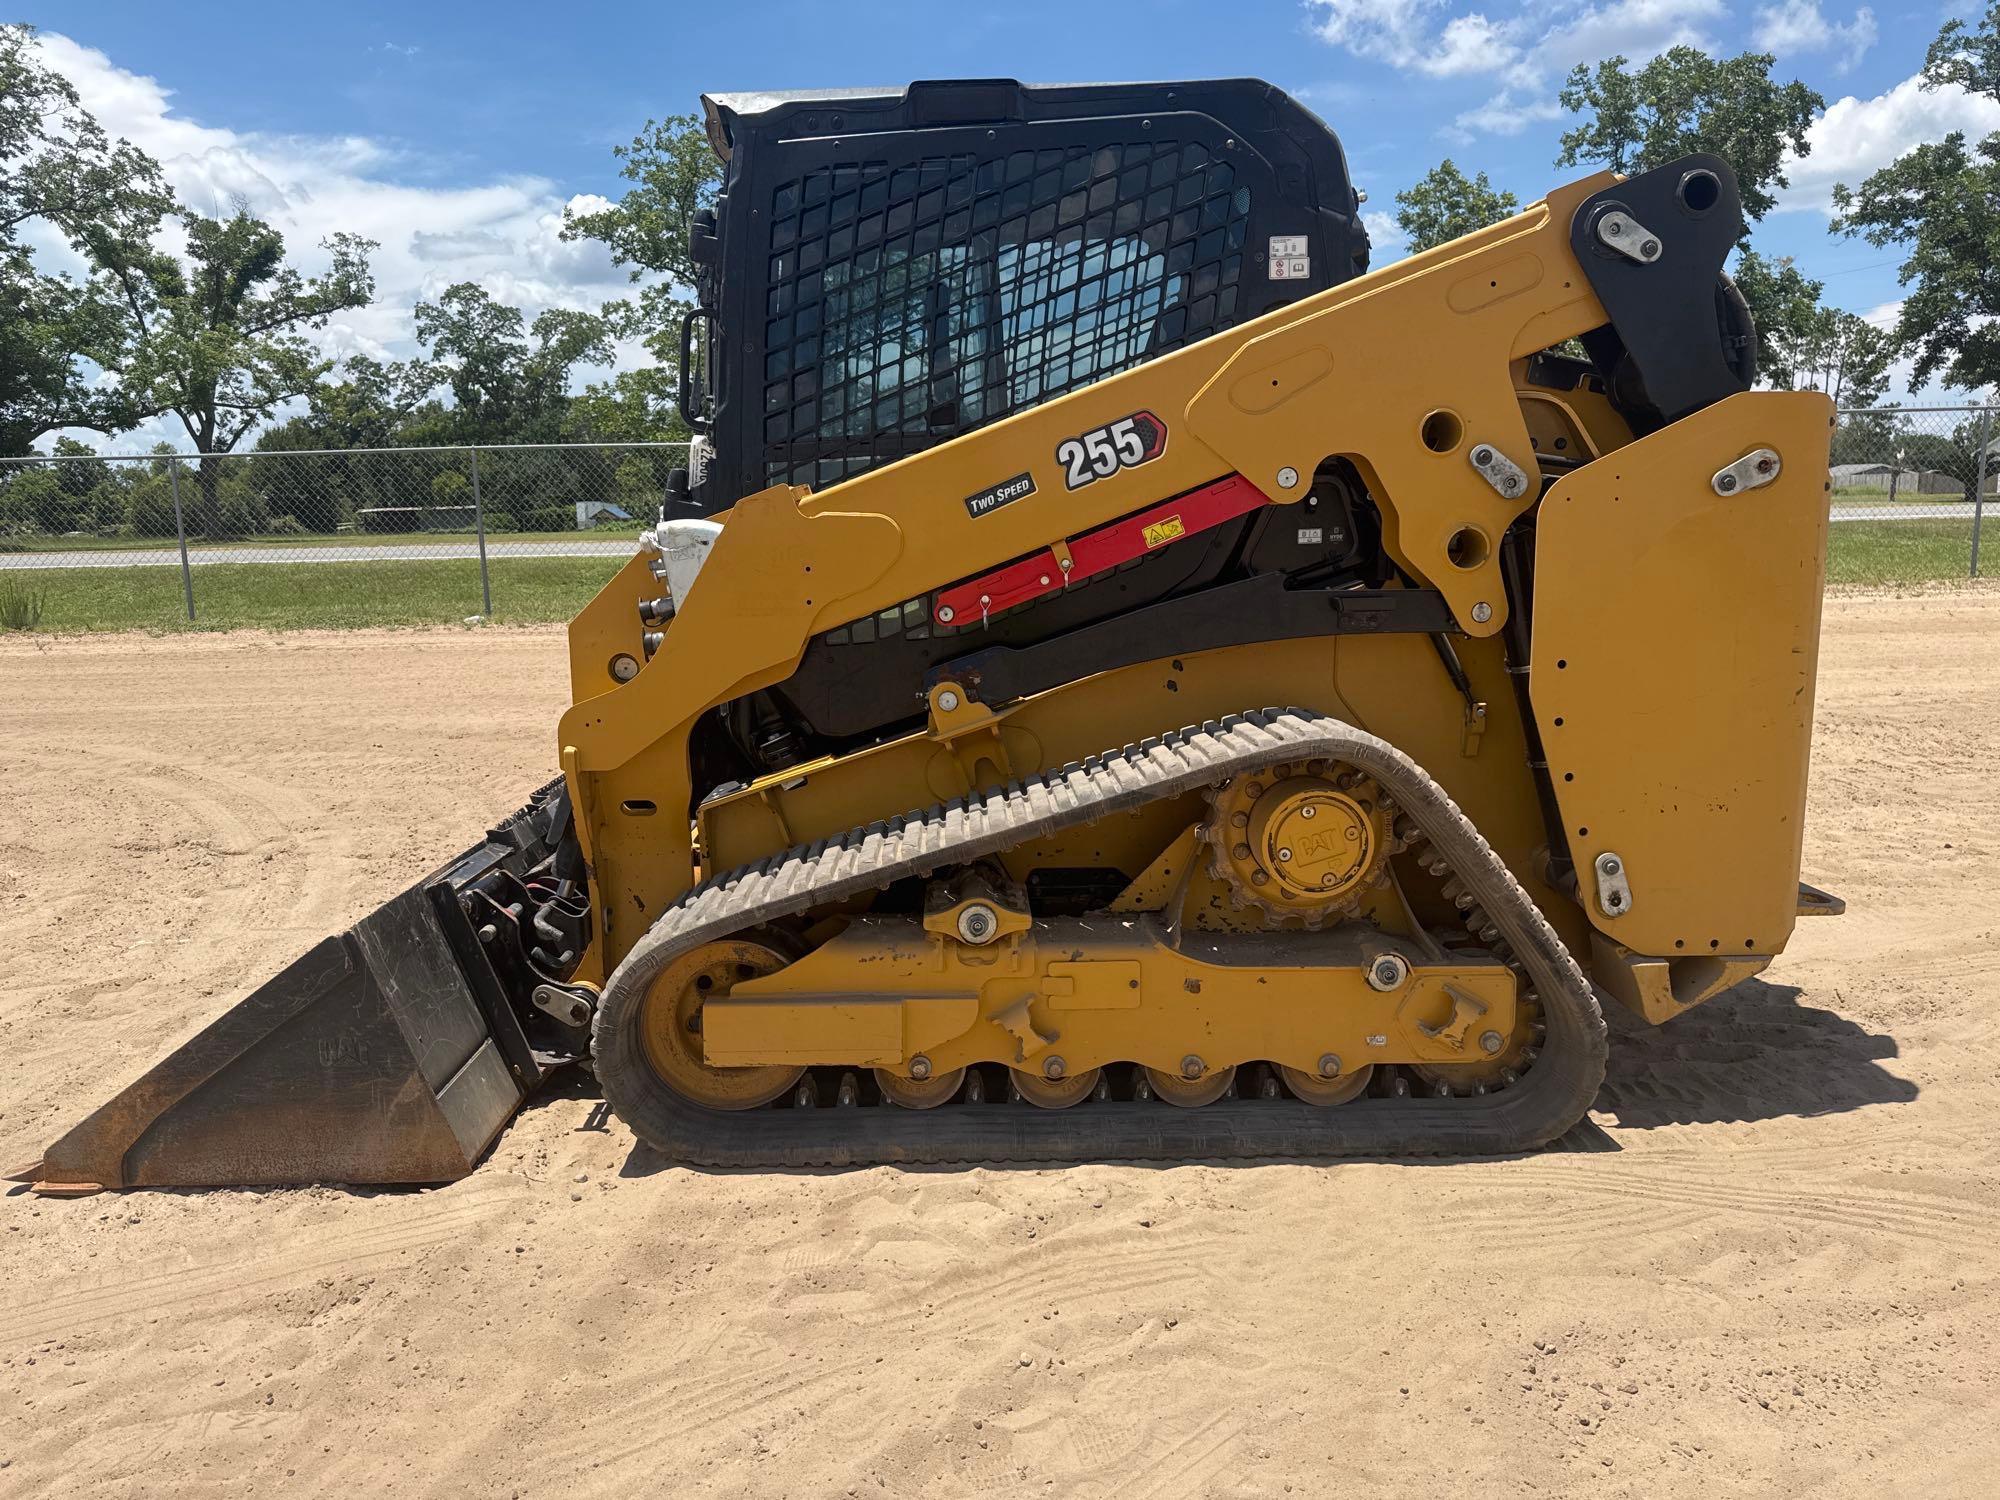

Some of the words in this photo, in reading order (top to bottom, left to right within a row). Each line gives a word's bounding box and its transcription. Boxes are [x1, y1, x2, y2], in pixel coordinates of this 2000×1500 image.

[1058, 418, 1144, 488] 255
[971, 494, 995, 512] TWO
[996, 480, 1029, 502] SPEED
[1297, 827, 1337, 856] CAT
